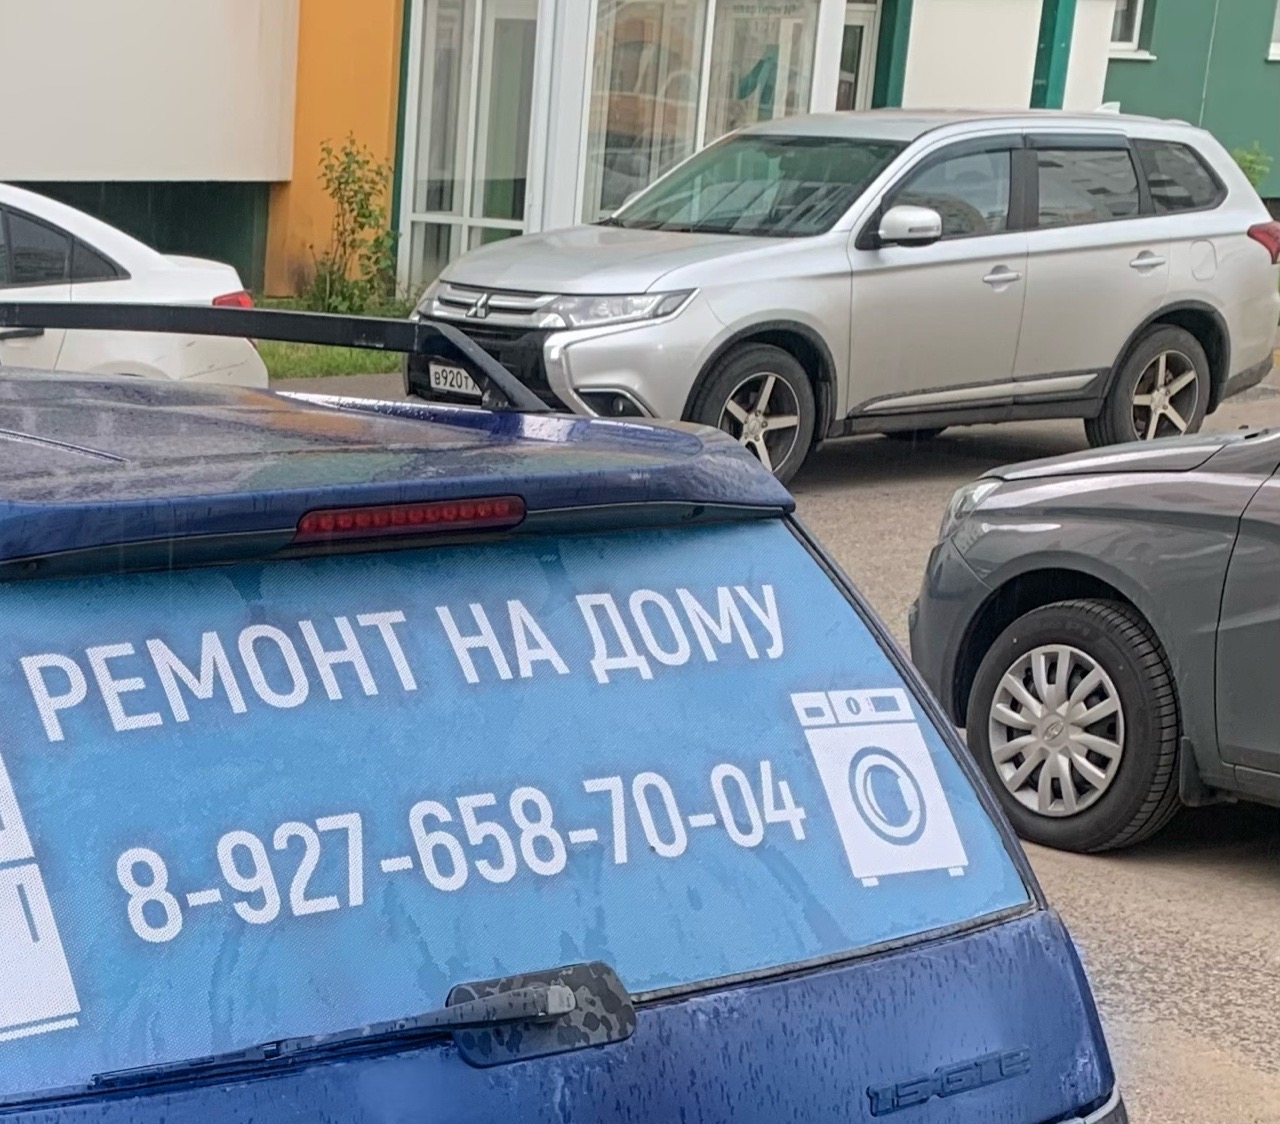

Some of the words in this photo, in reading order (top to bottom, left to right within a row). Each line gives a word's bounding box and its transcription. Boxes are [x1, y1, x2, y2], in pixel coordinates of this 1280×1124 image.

[19, 607, 419, 742] РЕМОНТ
[436, 598, 568, 685] НА
[575, 583, 787, 684] ДОМУ
[117, 760, 806, 944] 8-927-658-70-04
